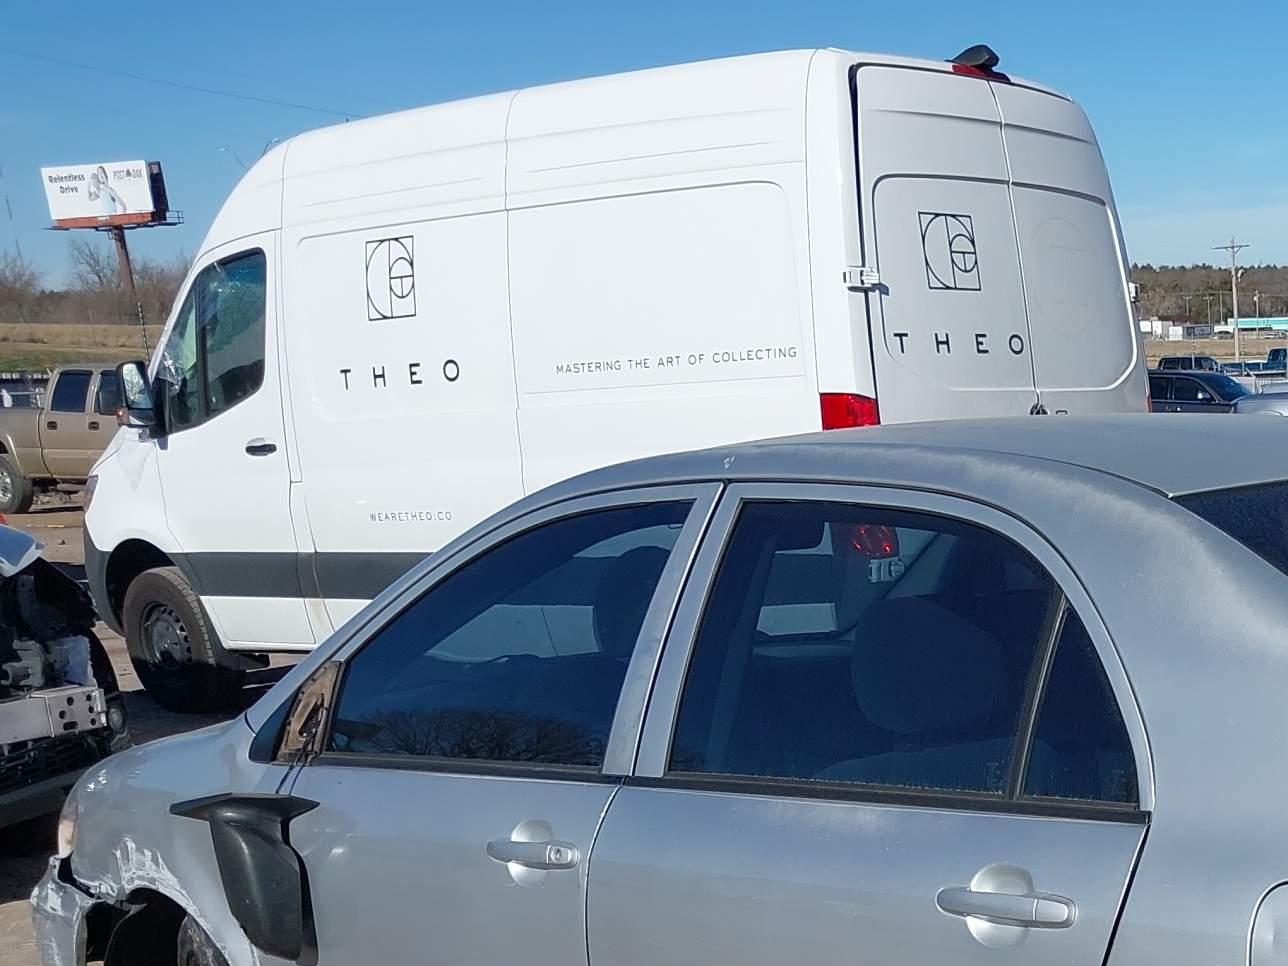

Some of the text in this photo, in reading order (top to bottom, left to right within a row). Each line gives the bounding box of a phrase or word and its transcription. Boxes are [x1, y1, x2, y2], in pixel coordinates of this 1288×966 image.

[48, 173, 86, 184] Relentless
[60, 186, 79, 194] Drive
[893, 332, 1025, 356] THEO
[556, 346, 798, 375] MASTERING THE ART OF COLLECTING
[339, 358, 460, 391] THEO
[369, 511, 452, 522] WEARETHEO.CO
